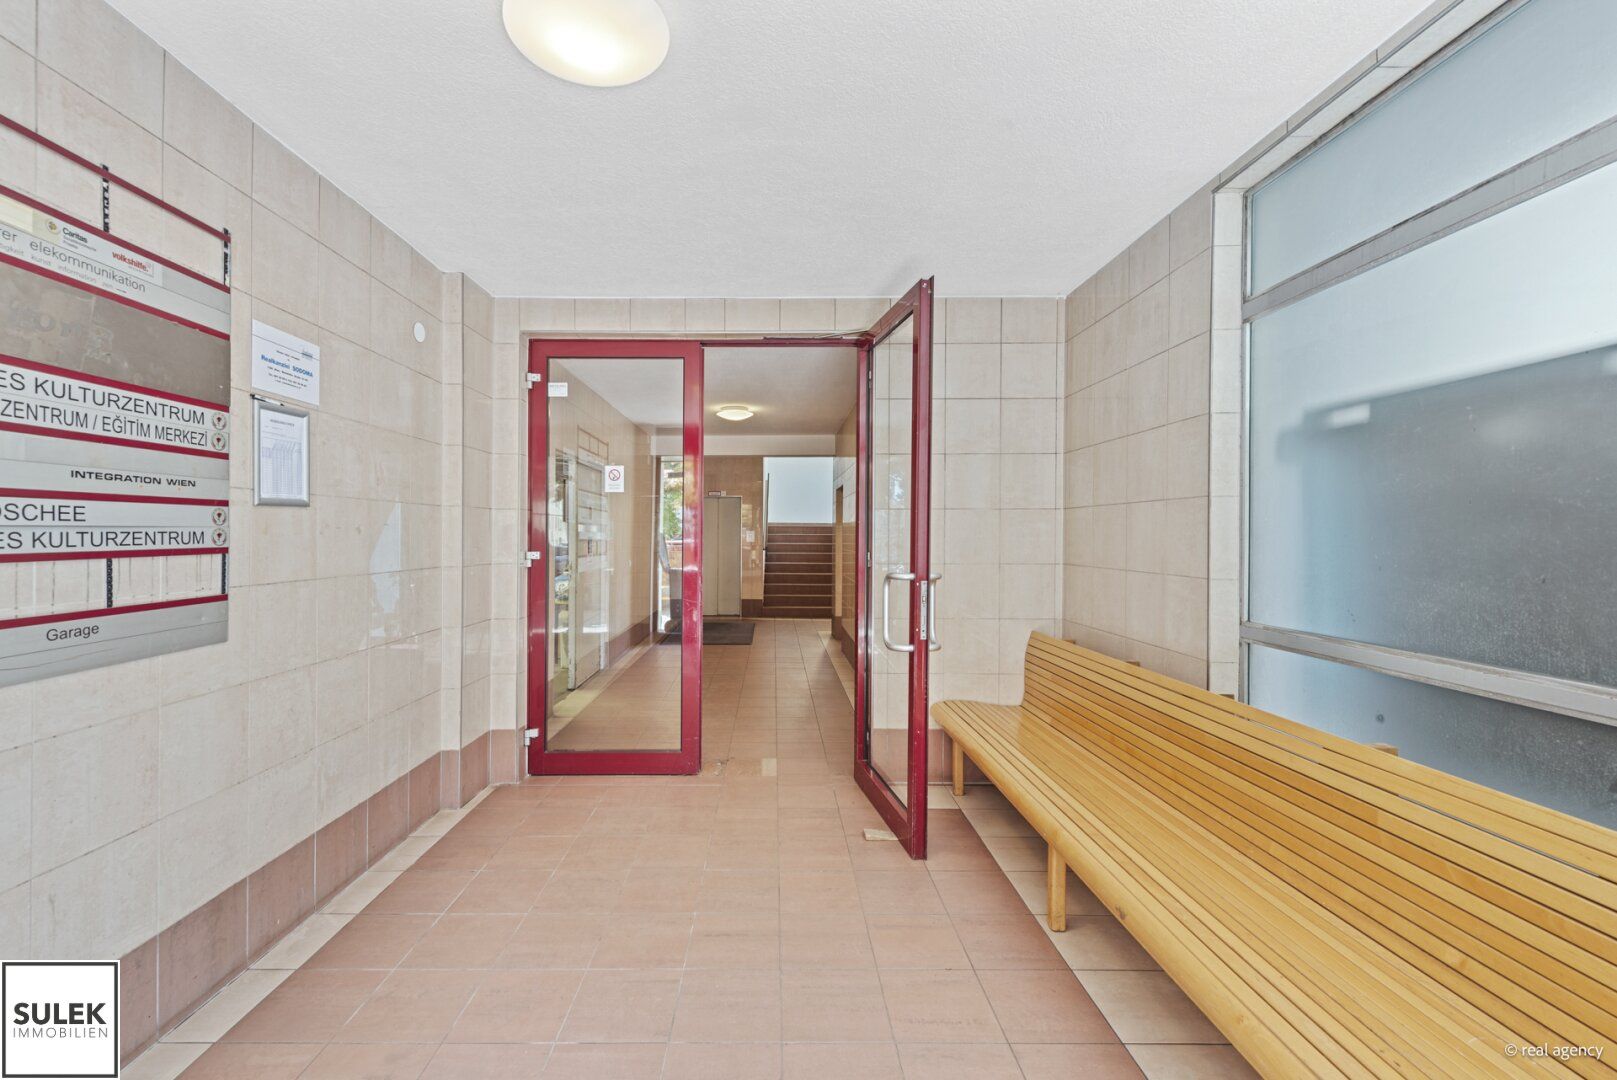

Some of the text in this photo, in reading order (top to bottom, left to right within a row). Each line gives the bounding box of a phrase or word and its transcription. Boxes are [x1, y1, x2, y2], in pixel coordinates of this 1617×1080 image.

[0, 228, 17, 242] er
[30, 241, 146, 292] elekommunikation
[34, 376, 205, 425] KULTURZENTRUM
[0, 398, 88, 429] ZENTRUM
[102, 415, 151, 438] EĞİTİM
[154, 424, 208, 447] MERKEZİ
[70, 470, 196, 487] INTEGRATION WIEN
[0, 503, 86, 522] SCHEE
[32, 531, 205, 549] KULTURZENTRUM
[46, 624, 100, 642] Garage
